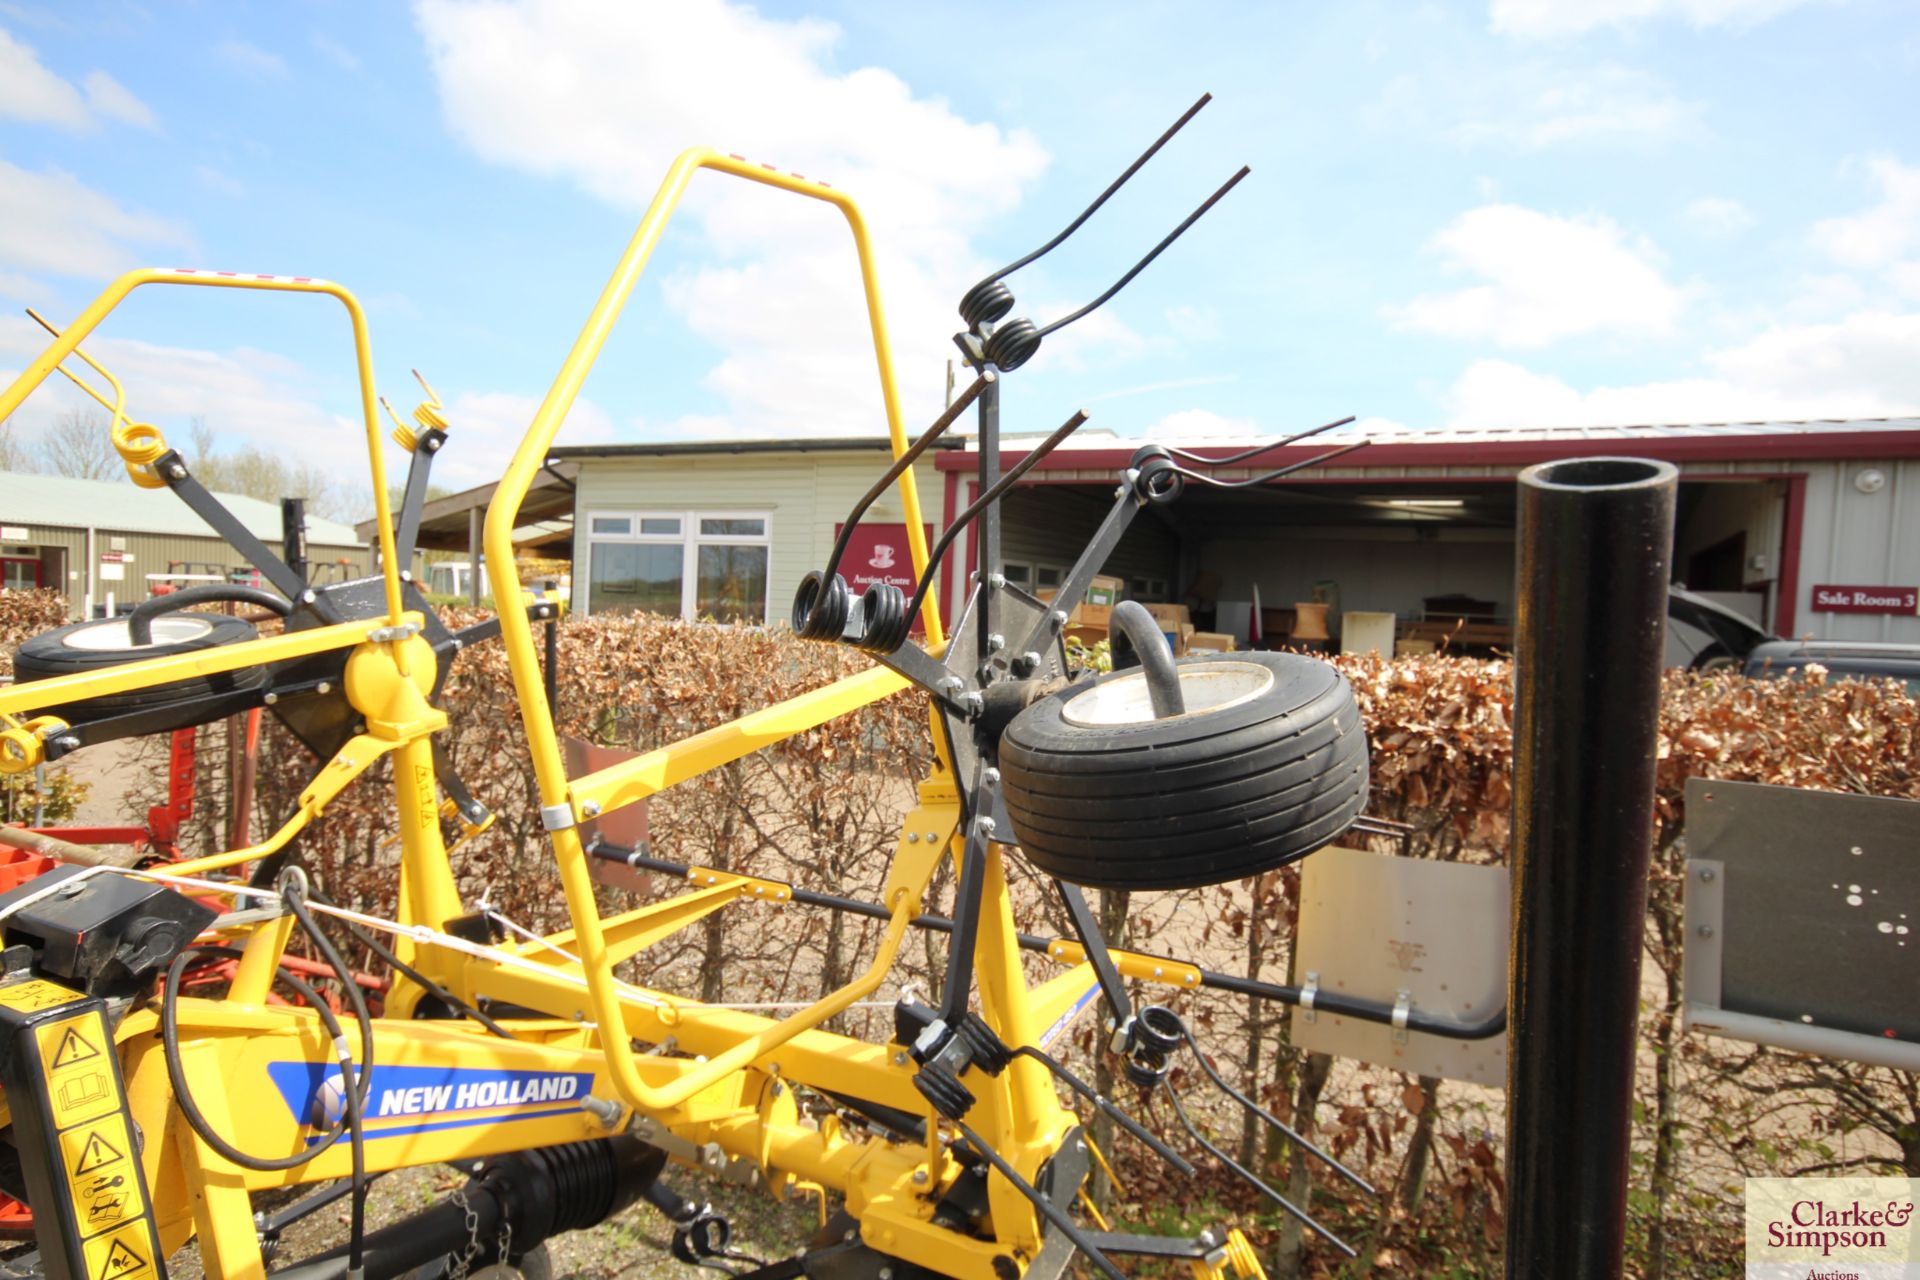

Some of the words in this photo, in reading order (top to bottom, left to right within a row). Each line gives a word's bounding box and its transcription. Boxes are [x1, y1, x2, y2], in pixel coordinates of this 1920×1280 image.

[853, 574, 883, 585] Auction
[884, 575, 911, 586] Centre
[1818, 591, 1850, 605] Sale
[1853, 592, 1901, 607] Room
[1904, 594, 1915, 608] 3
[379, 1084, 453, 1116] NEW
[455, 1076, 578, 1109] HOLLAND
